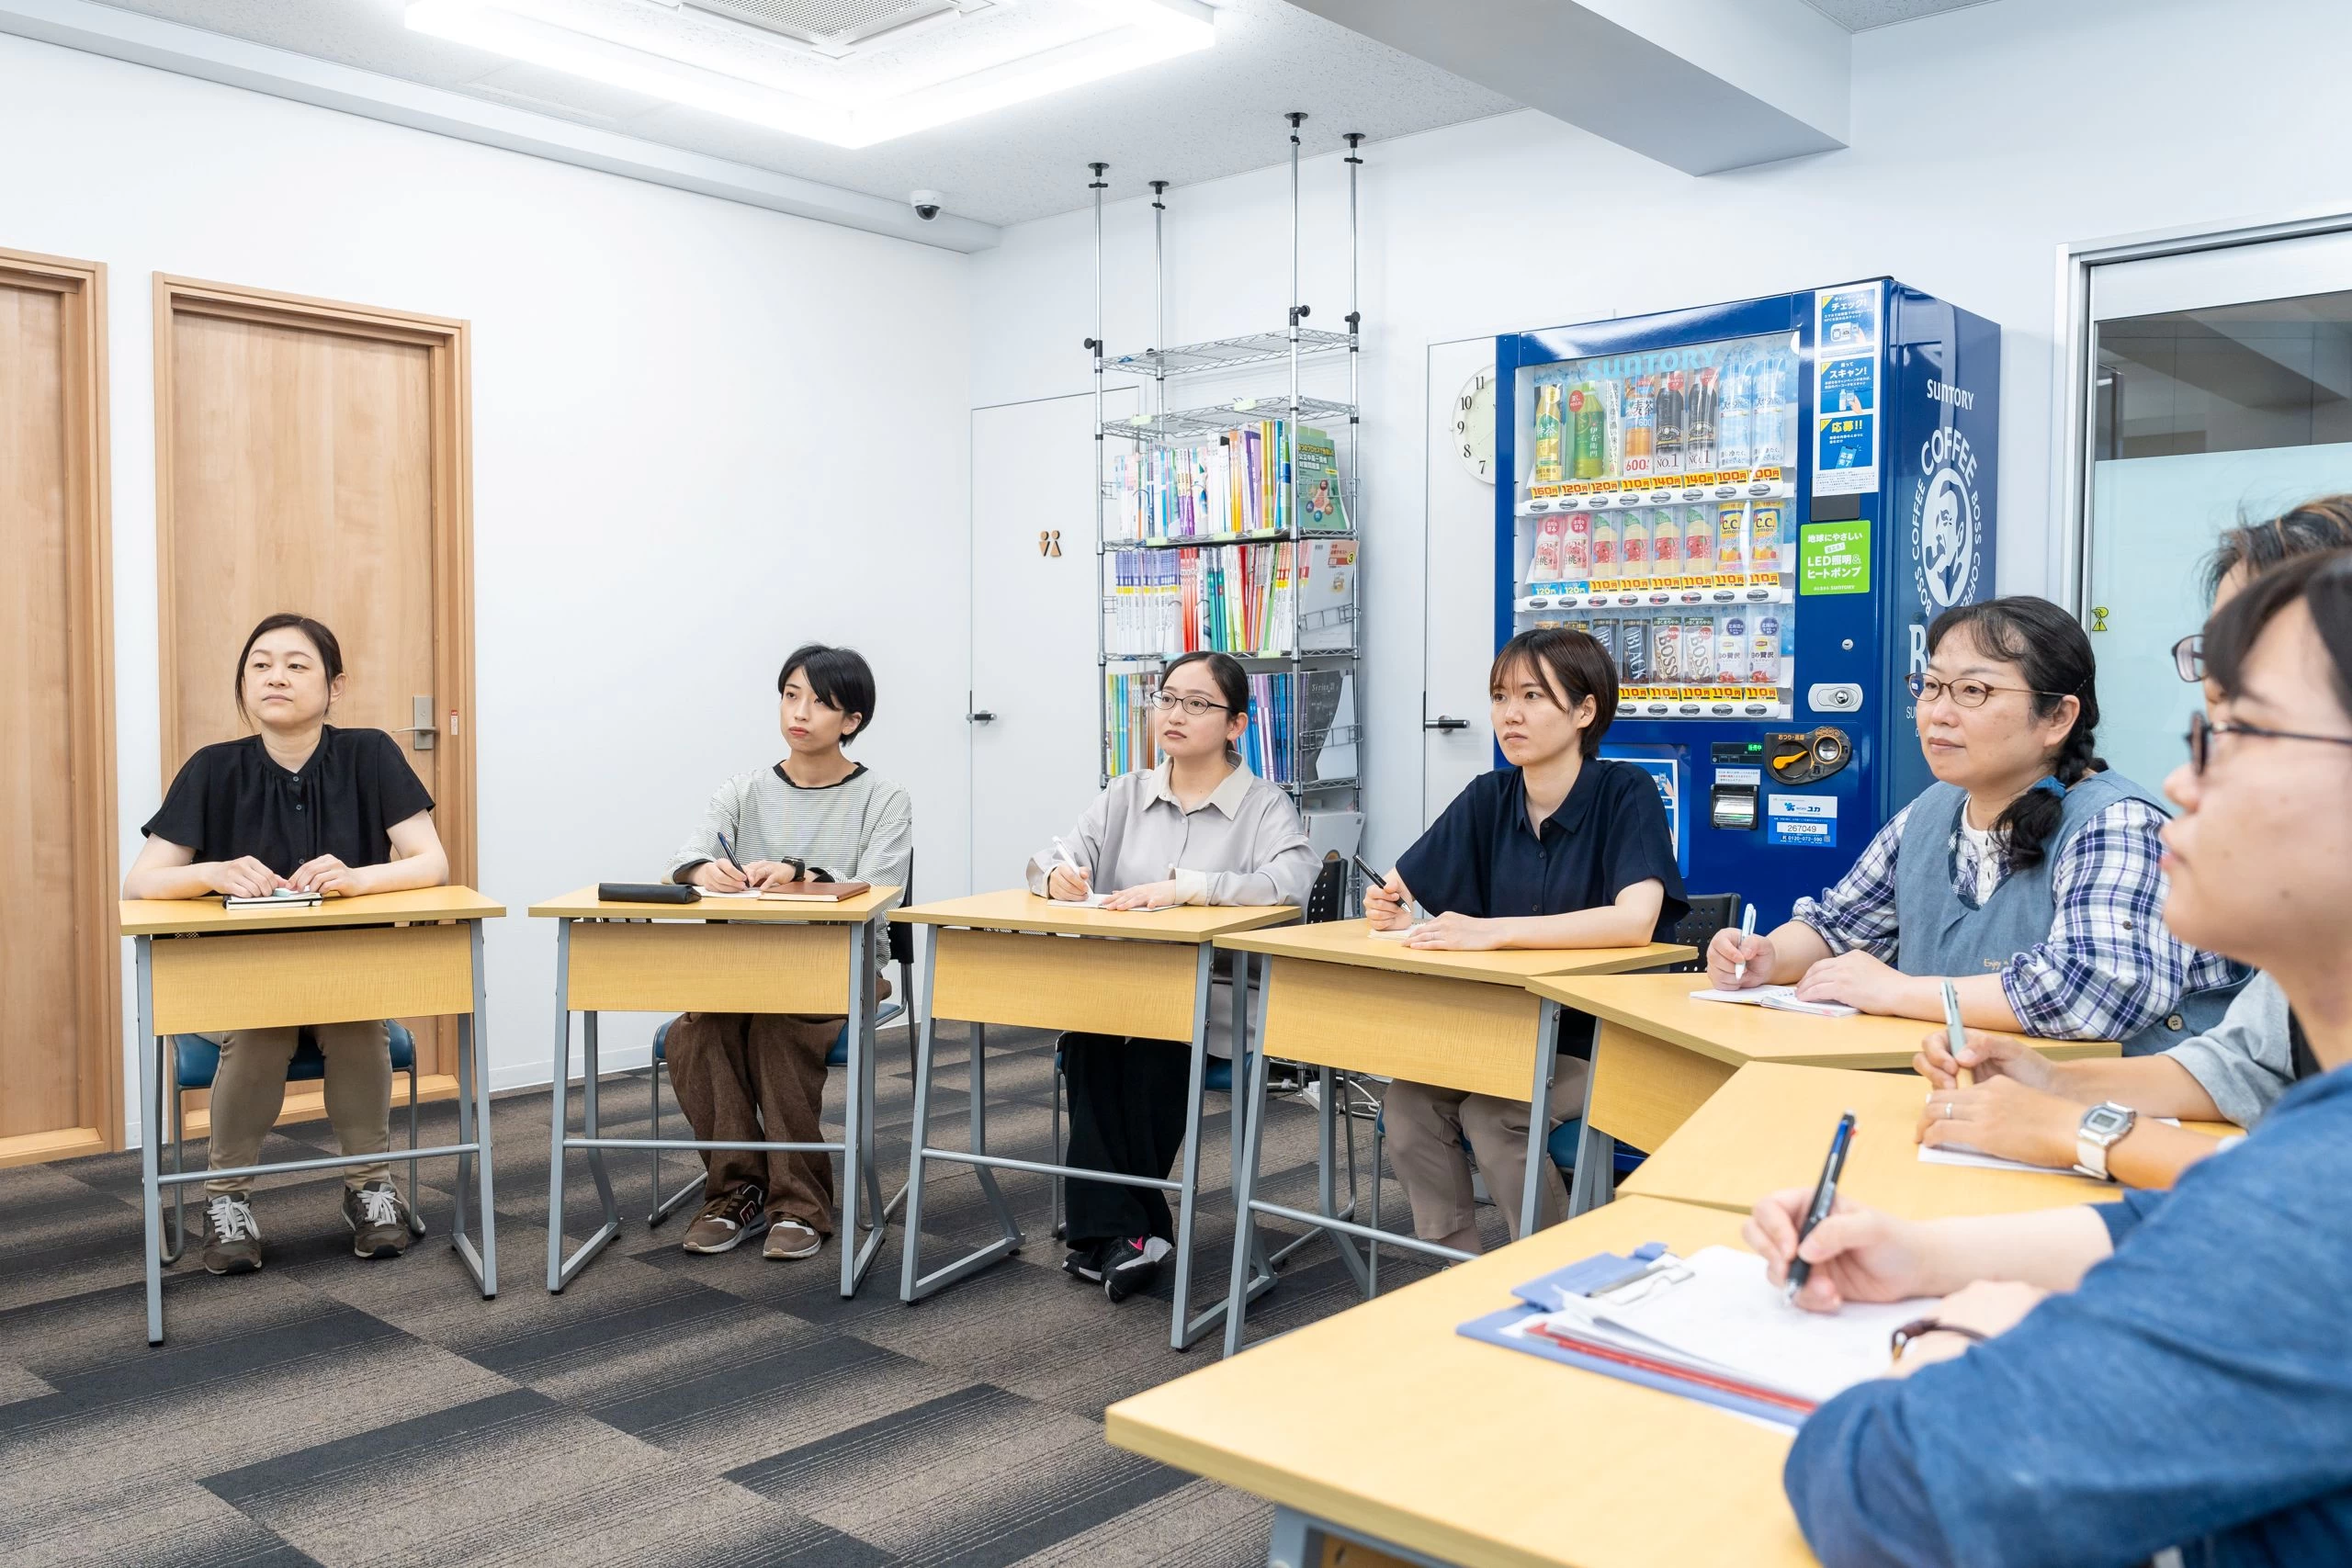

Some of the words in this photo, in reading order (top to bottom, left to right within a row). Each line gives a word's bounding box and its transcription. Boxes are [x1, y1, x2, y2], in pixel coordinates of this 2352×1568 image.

[1587, 346, 1718, 379] SUNTORY
[1829, 367, 1867, 379] スキャン!
[1476, 376, 1485, 390] 11
[1927, 378, 1974, 411] SUNTORY
[1461, 396, 1472, 411] 10
[1457, 421, 1464, 435] 9
[1831, 420, 1863, 434] 応募!!
[1464, 444, 1472, 457] 8
[1921, 426, 1978, 488] COFFEE
[1478, 459, 1487, 474] 7
[1654, 477, 1680, 486] 140円
[1685, 474, 1713, 484] 140円
[1717, 471, 1747, 481] 100円
[1562, 484, 1589, 493] 120円
[1591, 482, 1618, 492] 120円
[1623, 479, 1650, 489] 110円
[1532, 487, 1558, 496] 160円
[1756, 517, 1775, 528] C.C.
[1911, 479, 1926, 559] COFFEE
[1971, 491, 1982, 545] BOSS
[1722, 518, 1741, 530] C.C.
[1807, 532, 1863, 543] 地球にやさしい
[1348, 553, 1354, 563] 3
[1807, 554, 1861, 567] LED照明&
[1749, 573, 1778, 582] 110円
[1807, 566, 1862, 580] ヒートポンプ
[1653, 578, 1680, 587] 110円
[1684, 577, 1712, 586] 110円
[1716, 575, 1744, 584] 110円
[1960, 551, 1981, 607] COFFE
[1592, 581, 1618, 590] 110円
[1621, 581, 1648, 589] 110円
[1915, 566, 1932, 616] BOSS
[1626, 630, 1646, 680] BLACK
[1657, 636, 1679, 677] BOSS
[1690, 636, 1710, 677] BOSS
[1621, 688, 1646, 696] 110円
[1652, 688, 1679, 697] 110円
[1682, 688, 1711, 696] 110円
[1713, 688, 1741, 696] 110円
[1747, 688, 1776, 697] 110円
[1787, 824, 1817, 833] 267049
